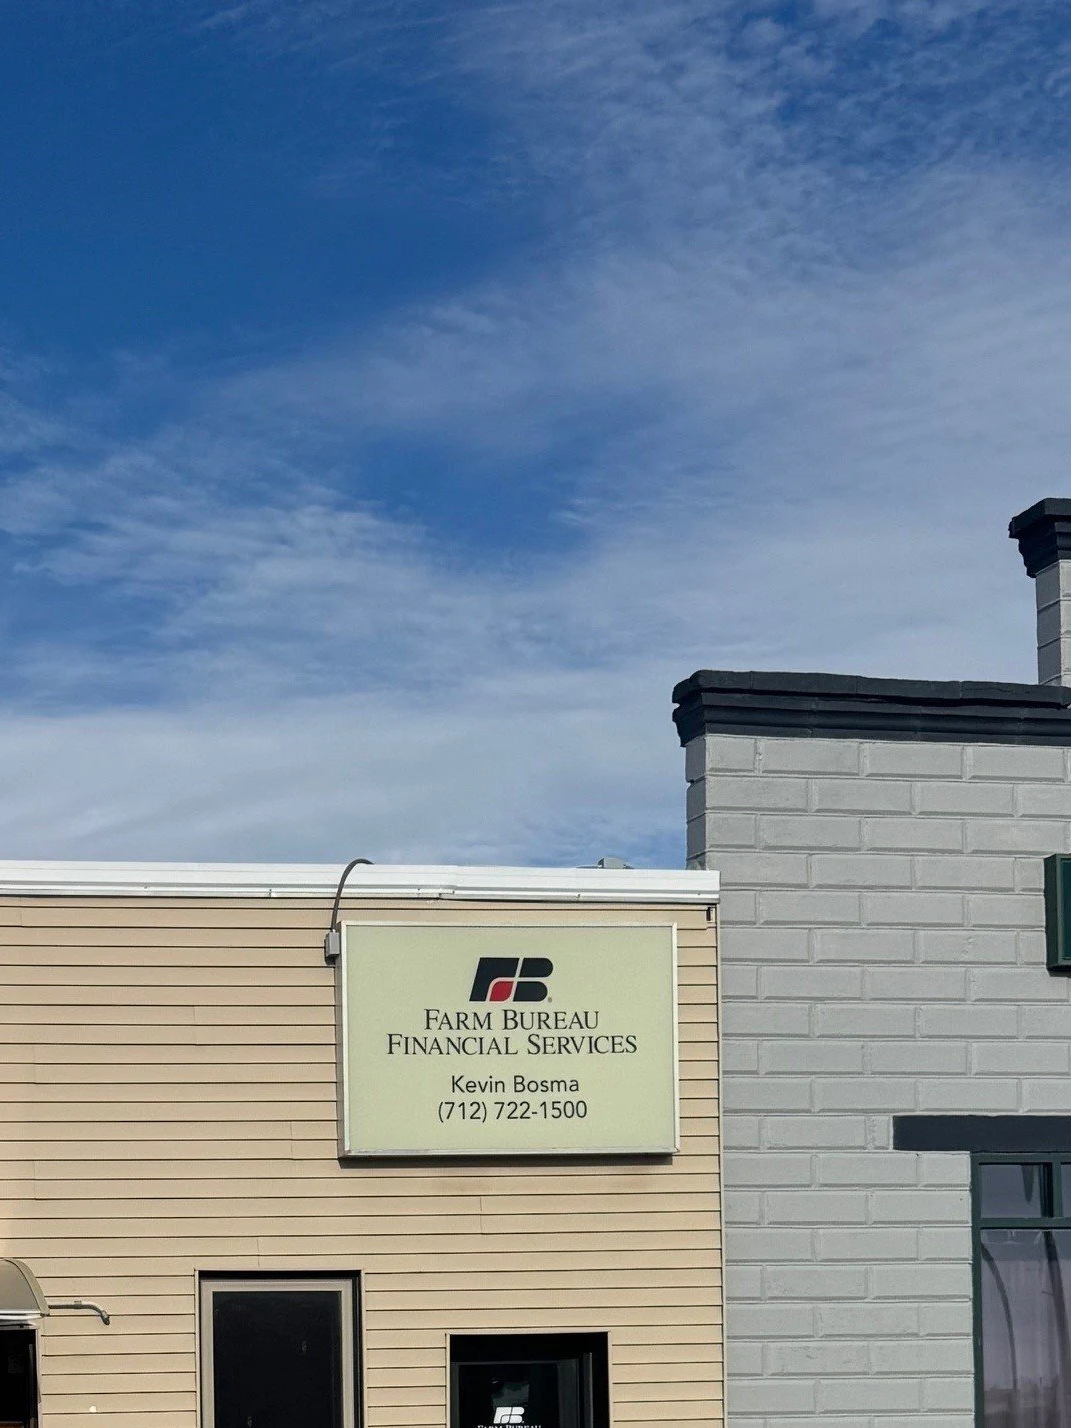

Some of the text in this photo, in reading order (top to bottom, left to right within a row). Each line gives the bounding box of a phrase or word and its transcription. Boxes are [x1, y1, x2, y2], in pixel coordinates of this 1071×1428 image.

[424, 1009, 599, 1030] FARM BUREAU
[387, 1033, 637, 1056] FINANCIAL SERVICES
[452, 1075, 579, 1093] Kevin Bosma
[438, 1101, 587, 1123] (712) 722-1500
